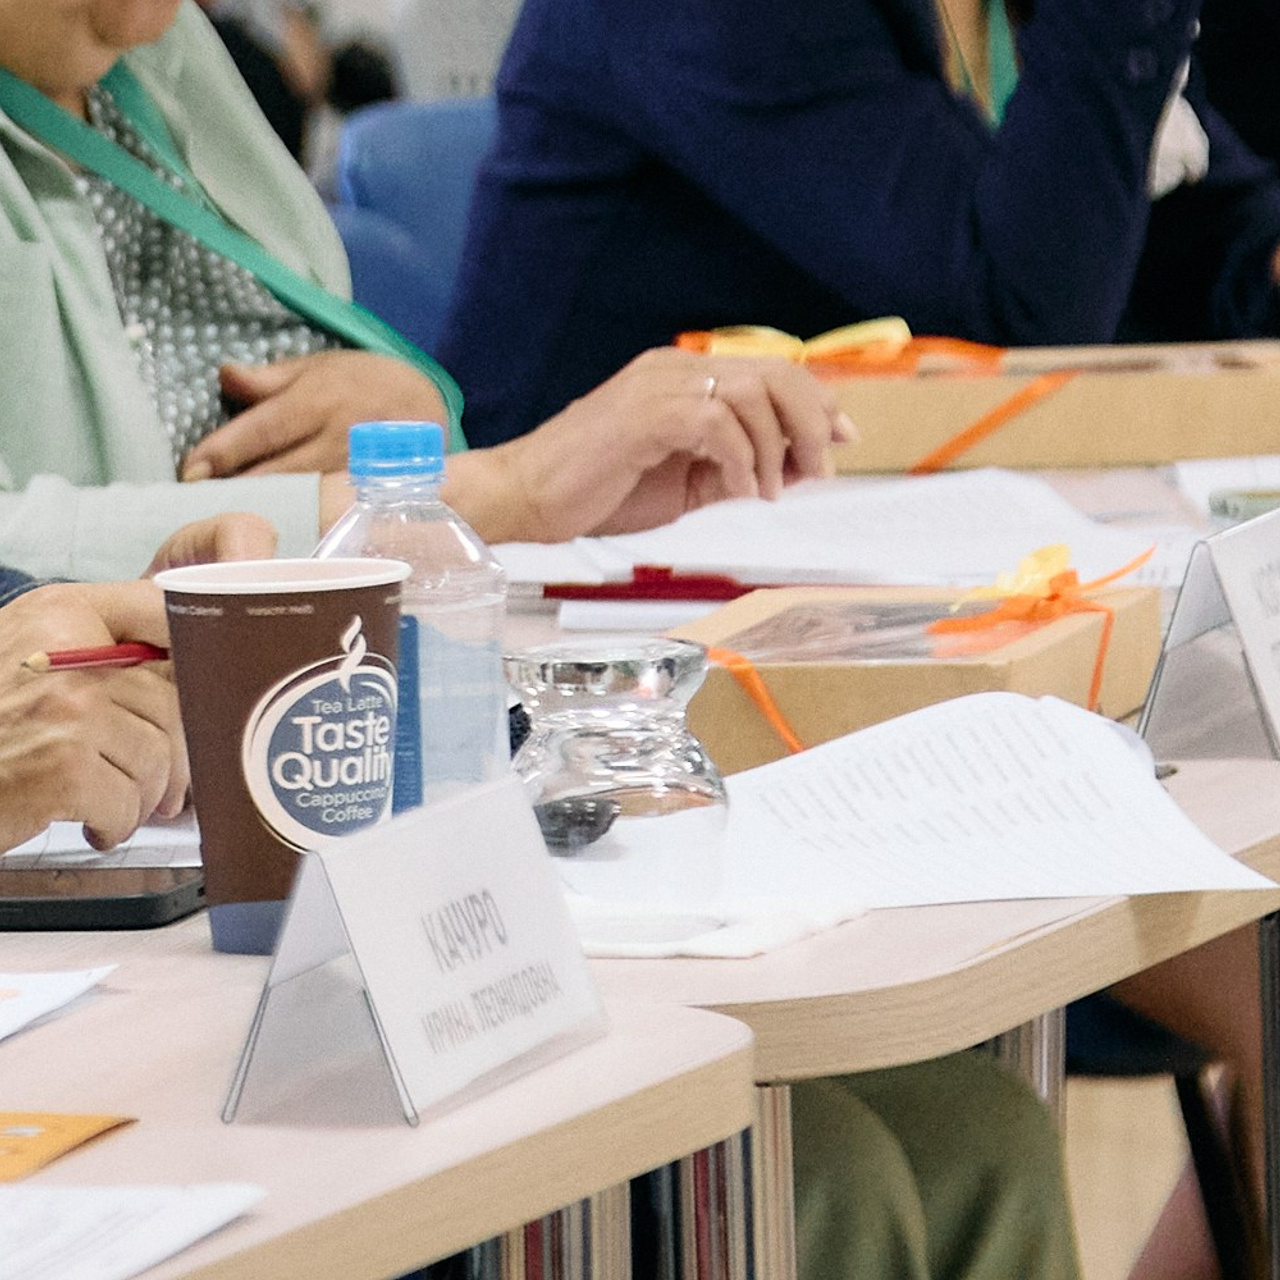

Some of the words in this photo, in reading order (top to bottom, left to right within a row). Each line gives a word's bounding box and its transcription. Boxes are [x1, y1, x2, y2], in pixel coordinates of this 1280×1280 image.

[311, 699, 343, 714] Tea
[347, 696, 383, 712] Latte
[291, 711, 391, 754] Taste
[322, 804, 373, 823] Coffee
[420, 888, 508, 973] КАЧУРО
[420, 1000, 477, 1054] ИРИНА
